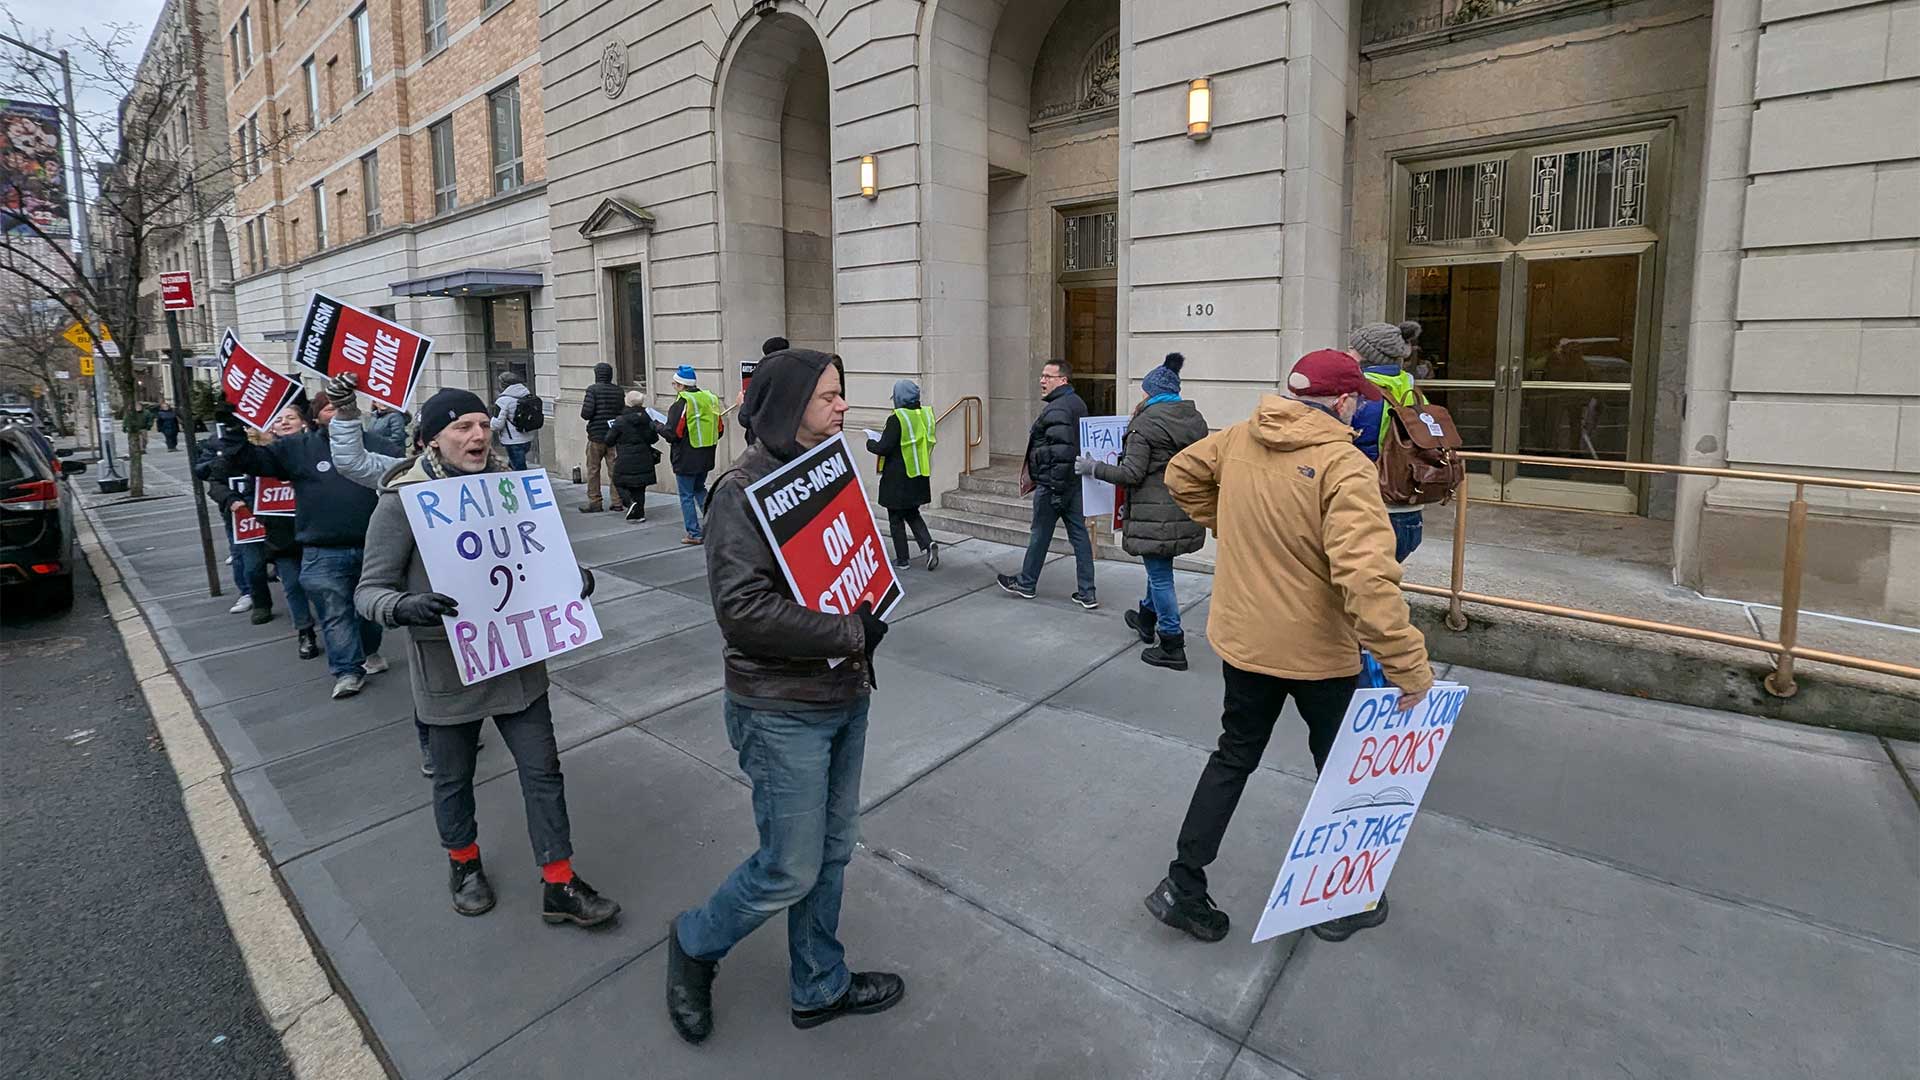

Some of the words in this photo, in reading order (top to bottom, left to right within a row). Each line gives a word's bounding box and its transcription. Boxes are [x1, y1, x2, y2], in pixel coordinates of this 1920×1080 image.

[302, 301, 335, 368] ARTS-MSM
[1186, 303, 1214, 317] 130
[342, 332, 370, 365] ON
[367, 328, 401, 397] STRIKE
[226, 364, 247, 391] ON
[238, 368, 274, 418] STRIKE
[262, 486, 296, 503] STRI
[416, 474, 553, 529] RAI$E
[763, 452, 848, 522] ARTS-MSM
[455, 520, 546, 561] OUR
[822, 511, 854, 566] ON
[818, 535, 879, 616] STRIKE
[455, 600, 588, 682] RATES
[1422, 688, 1467, 727] YOUR
[1348, 727, 1444, 785] BOOKS
[1290, 814, 1357, 862] LET'S
[1356, 812, 1413, 850] TAKE
[1271, 872, 1295, 910] A
[1300, 848, 1392, 906] LOOK
